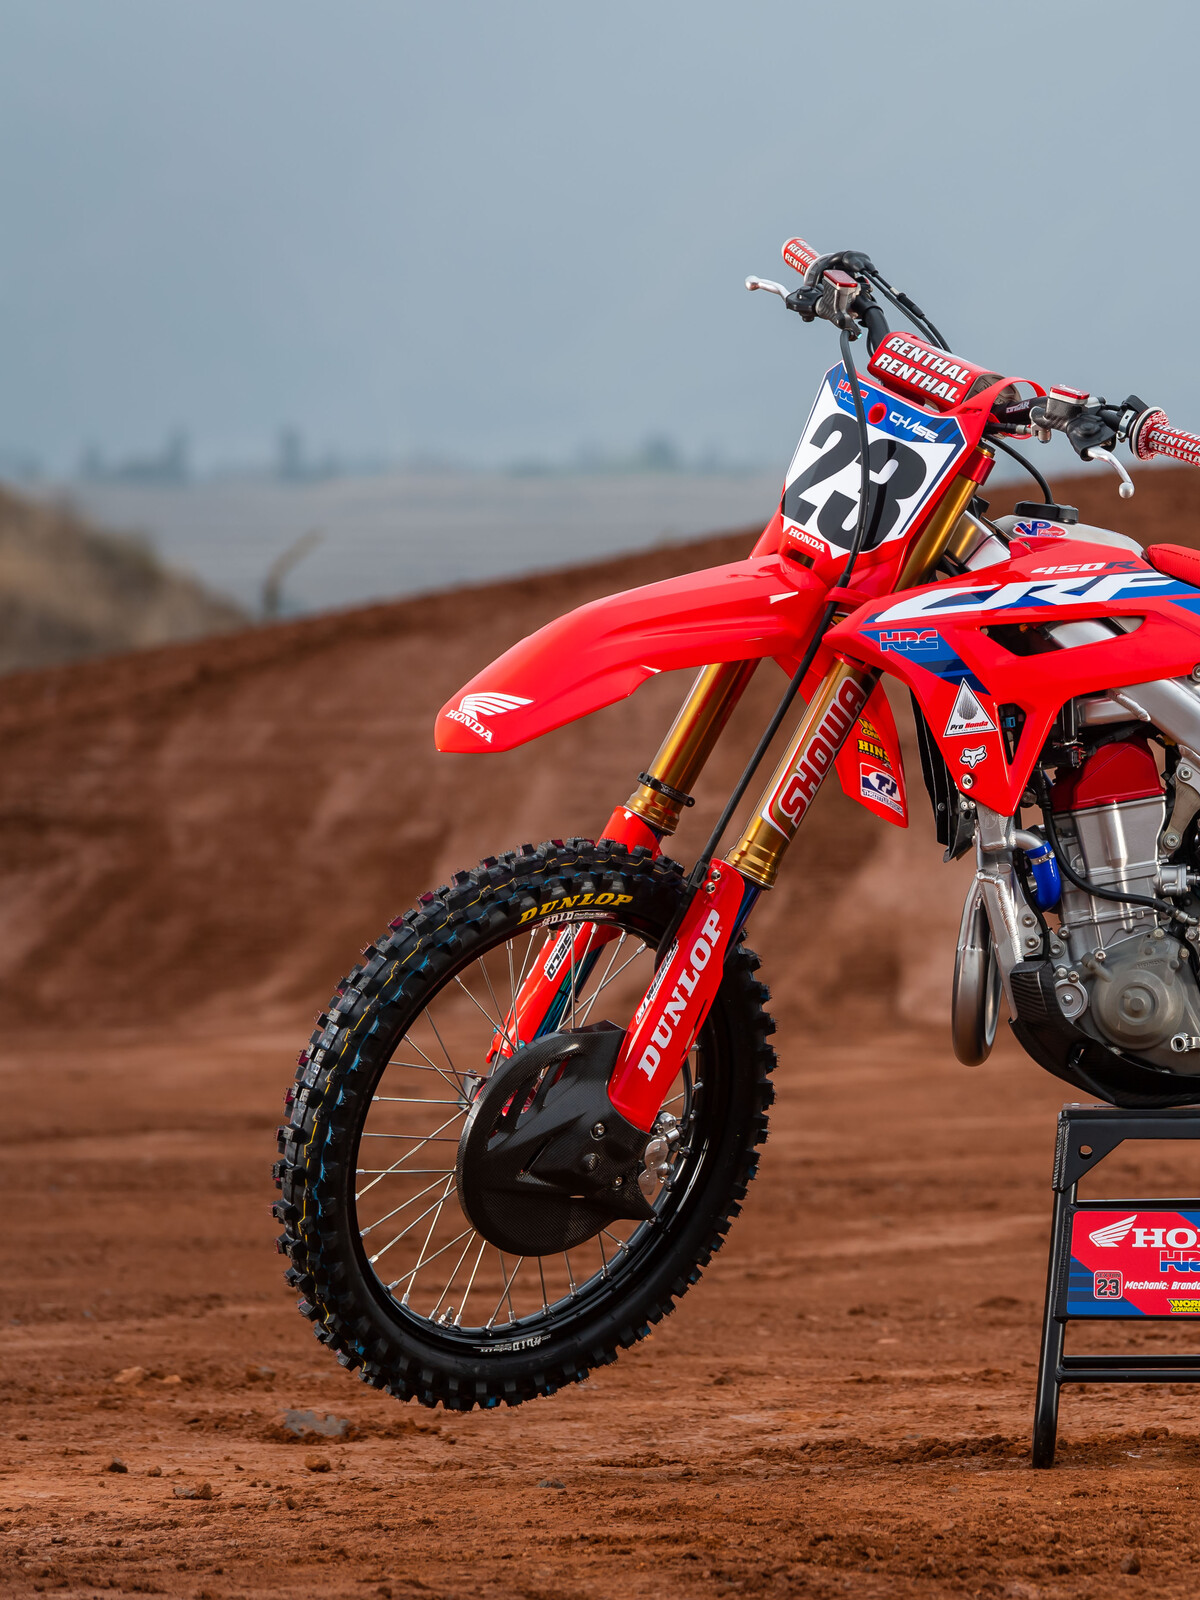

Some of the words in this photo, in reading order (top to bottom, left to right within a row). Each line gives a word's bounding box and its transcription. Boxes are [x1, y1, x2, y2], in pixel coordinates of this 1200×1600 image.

[885, 336, 970, 385] RENTHAL
[874, 353, 958, 403] RENTHAL
[889, 411, 939, 443] CHASE
[782, 413, 927, 552] 23
[788, 527, 825, 552] HONDA
[1014, 520, 1052, 537] VP
[1030, 561, 1140, 574] 450R
[875, 573, 1175, 622] CRF
[879, 629, 938, 651] HRC
[445, 709, 493, 743] HONDA
[778, 676, 867, 828] SHOWA
[517, 892, 634, 926] DUNLOP
[637, 908, 721, 1082] DUNLOP
[1096, 1278, 1120, 1297] 23
[1124, 1280, 1169, 1290] Mechanic:
